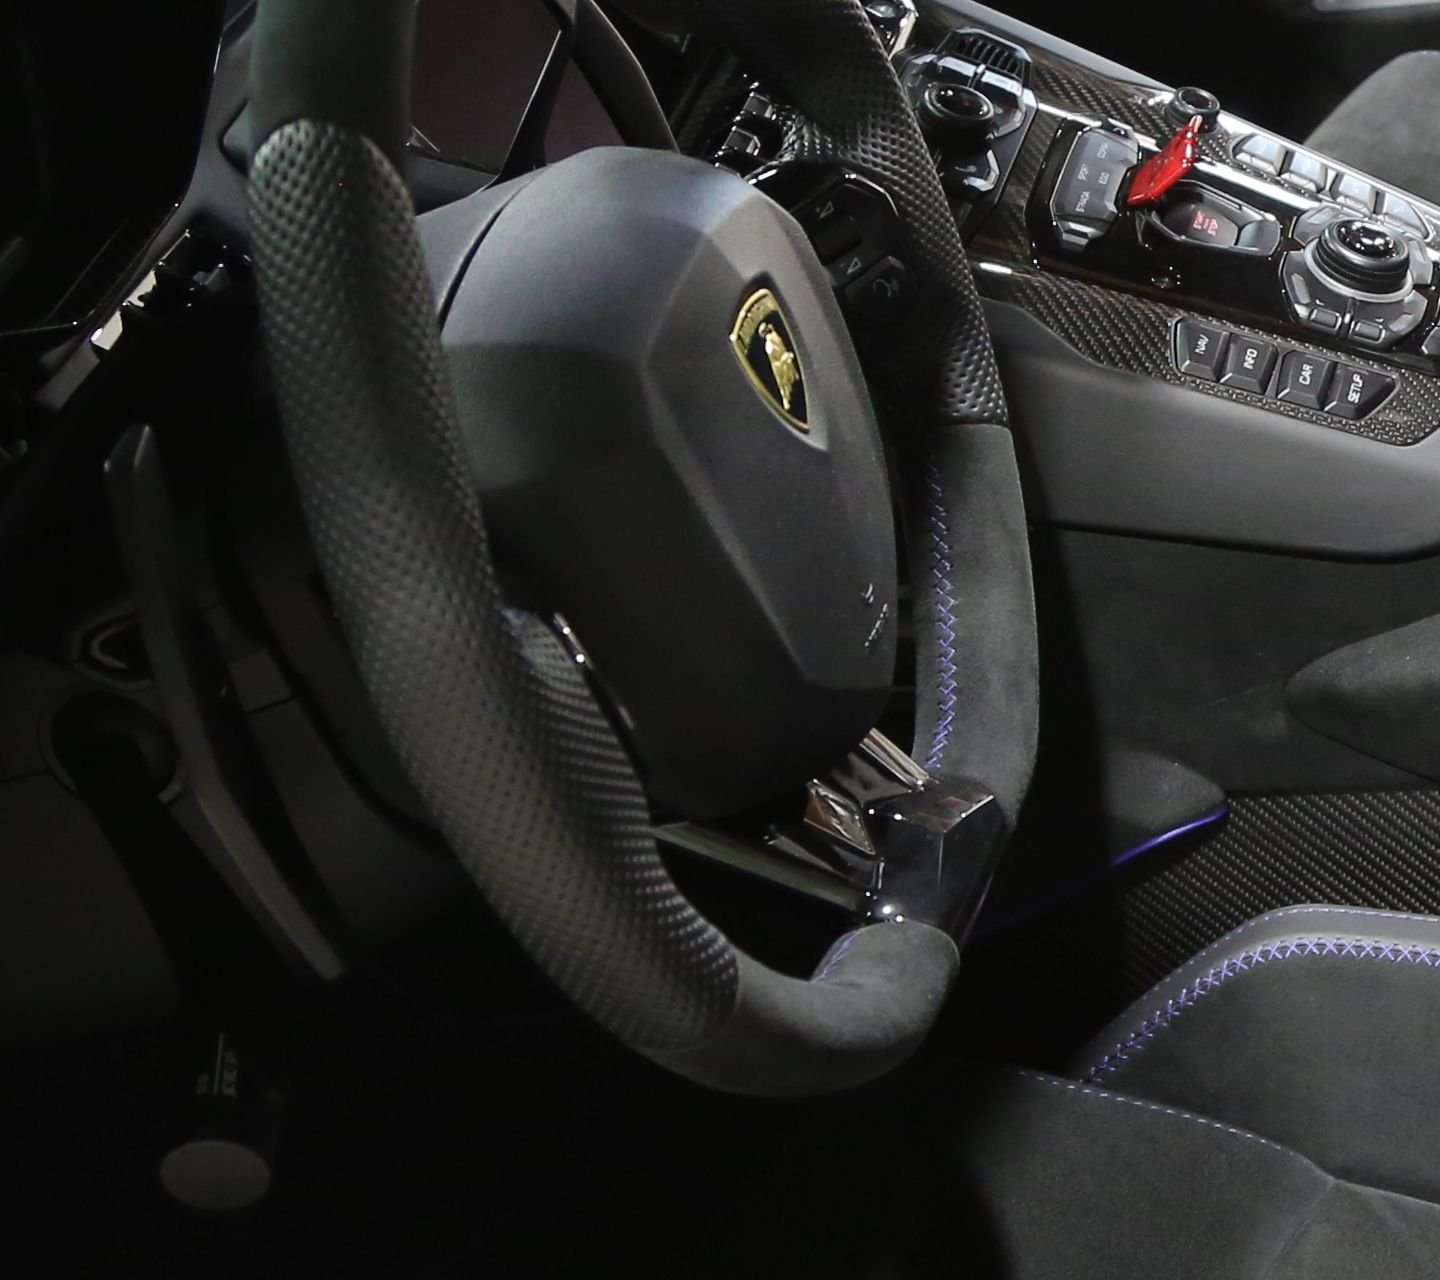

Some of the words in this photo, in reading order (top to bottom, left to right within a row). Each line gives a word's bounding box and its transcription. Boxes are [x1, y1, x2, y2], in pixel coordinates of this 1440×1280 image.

[1207, 218, 1218, 237] STOP
[1194, 334, 1209, 355] NAV
[1242, 348, 1258, 370] INFO
[1298, 363, 1313, 386] CAR
[1347, 372, 1364, 404] SETUP
